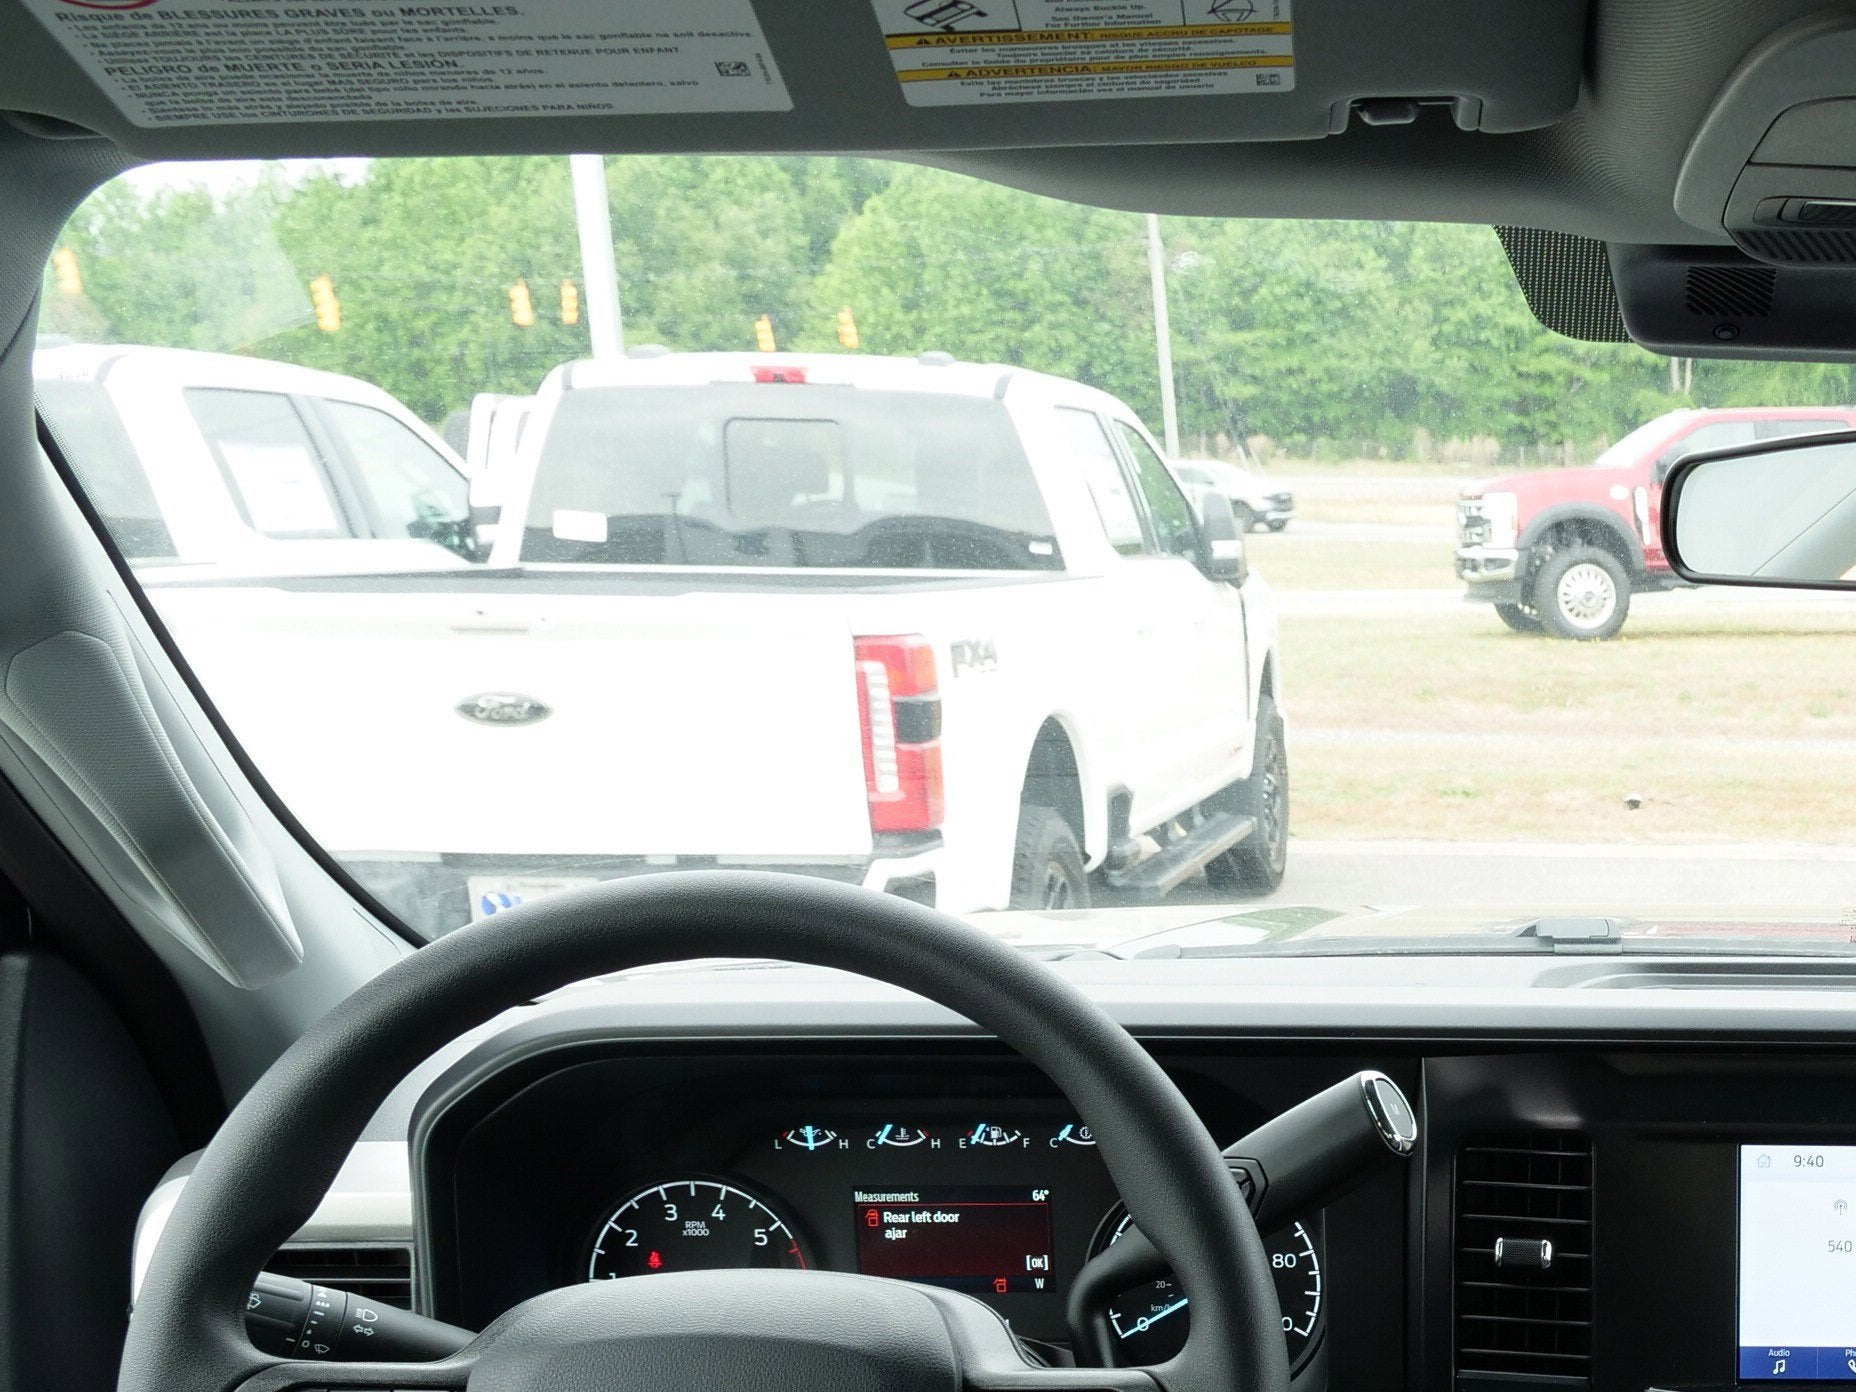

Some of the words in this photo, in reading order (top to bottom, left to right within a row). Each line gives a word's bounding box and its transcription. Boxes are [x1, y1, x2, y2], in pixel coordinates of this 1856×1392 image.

[55, 12, 124, 22] Risque
[129, 11, 154, 21] de
[157, 9, 281, 20] BLESSURES
[284, 7, 366, 18] GRAVES
[371, 9, 397, 17] ou
[399, 6, 525, 17] MORTELLES.
[103, 64, 193, 77] PELIGRO
[197, 64, 221, 74] de
[223, 61, 307, 73] MUERTE
[325, 60, 383, 71] SERIA
[774, 1139, 783, 1150] L
[839, 1139, 849, 1149] H
[866, 1138, 876, 1150] C
[931, 1138, 941, 1149] H
[958, 1138, 967, 1149] E
[1022, 1138, 1031, 1148] F
[1049, 1138, 1058, 1149] C
[1793, 1154, 1825, 1169] 9:40
[854, 1190, 920, 1203] Measurements
[664, 1204, 678, 1222] 3
[711, 1204, 726, 1221] 4
[883, 1211, 909, 1223] Rear
[911, 1211, 931, 1223] left
[933, 1211, 960, 1223] door
[685, 1220, 706, 1229] RPM
[624, 1230, 639, 1247] 2
[682, 1228, 710, 1237] x1000
[754, 1229, 769, 1246] 5
[884, 1227, 908, 1240] ajar
[1827, 1240, 1853, 1254] 540
[1272, 1253, 1297, 1269] 80
[1034, 1278, 1044, 1290] W
[1768, 1349, 1790, 1358] Audio
